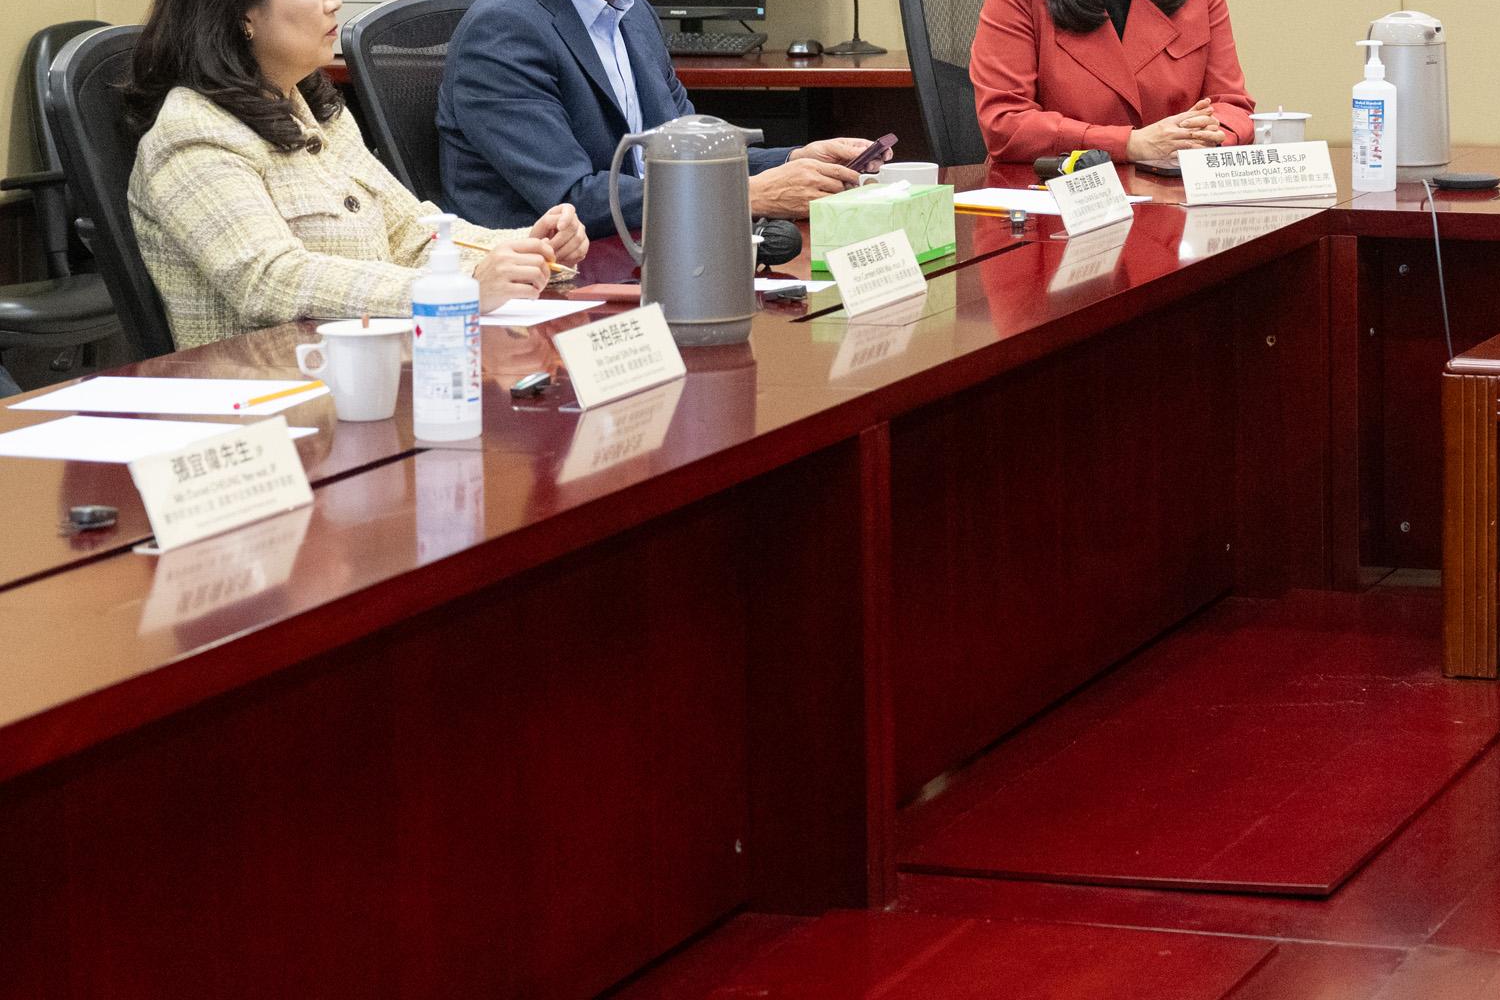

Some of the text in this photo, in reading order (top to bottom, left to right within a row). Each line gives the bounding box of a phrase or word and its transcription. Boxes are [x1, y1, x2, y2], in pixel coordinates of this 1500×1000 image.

[1204, 148, 1281, 168] 葛珮帆議員
[1231, 168, 1261, 178] Elizabeth
